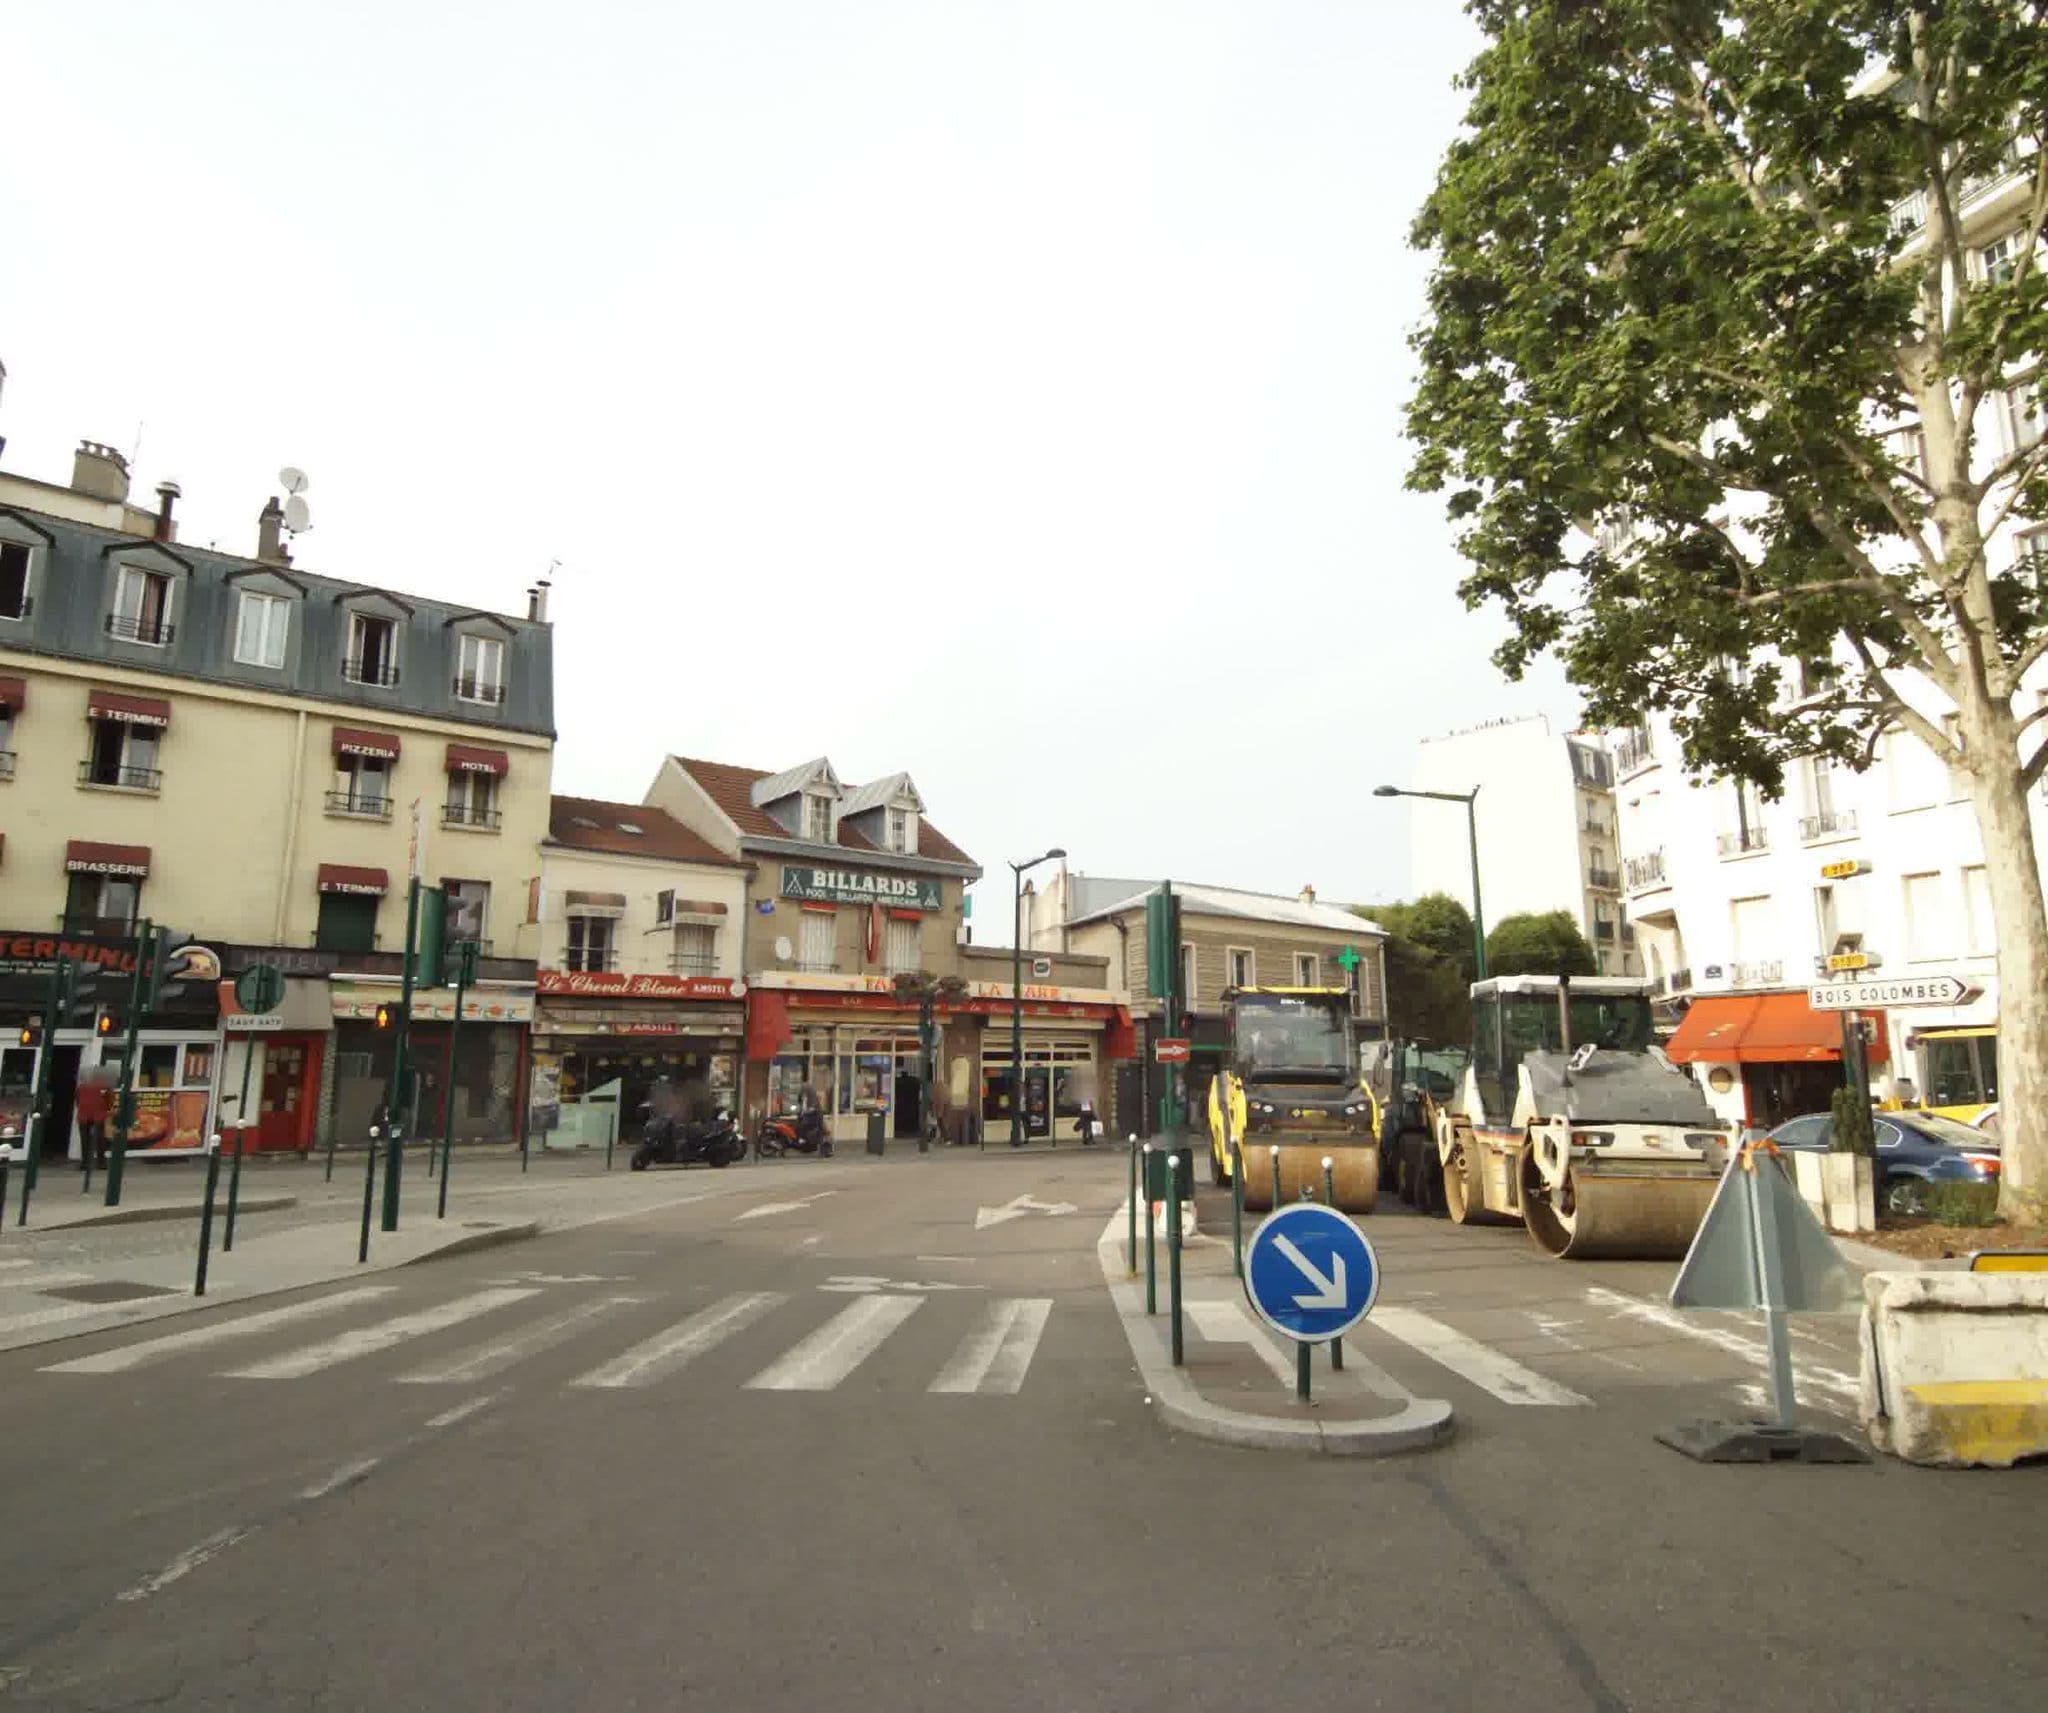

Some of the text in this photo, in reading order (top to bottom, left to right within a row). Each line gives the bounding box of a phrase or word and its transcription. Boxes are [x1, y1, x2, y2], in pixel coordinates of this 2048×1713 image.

[341, 743, 395, 758] PIZZERIA
[461, 761, 496, 773] HOTEL
[67, 860, 149, 876] BRASSERIE
[812, 870, 918, 896] BILLARDS
[806, 886, 826, 898] POOL
[567, 973, 632, 994] Cheval
[631, 976, 689, 996] Blanc
[1814, 983, 1950, 1004] BOIS COLOMBES
